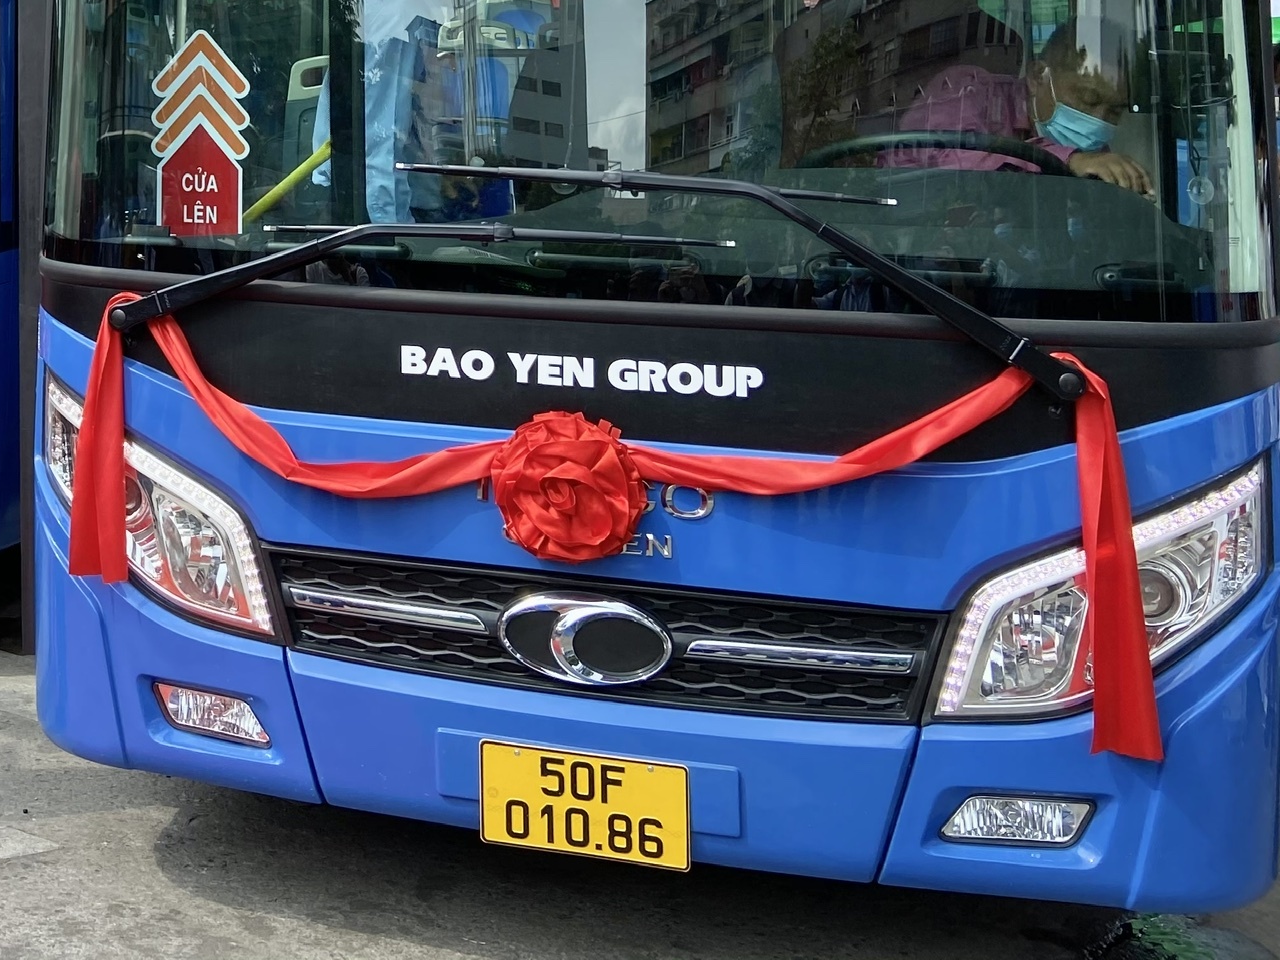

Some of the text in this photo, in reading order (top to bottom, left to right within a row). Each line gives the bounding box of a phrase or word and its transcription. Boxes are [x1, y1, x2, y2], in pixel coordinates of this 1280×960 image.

[182, 167, 219, 193] CỬA
[183, 201, 217, 224] LÊN
[400, 344, 764, 398] BAO YEN GROUP
[540, 756, 626, 804] 50F
[505, 799, 664, 859] 010.86
